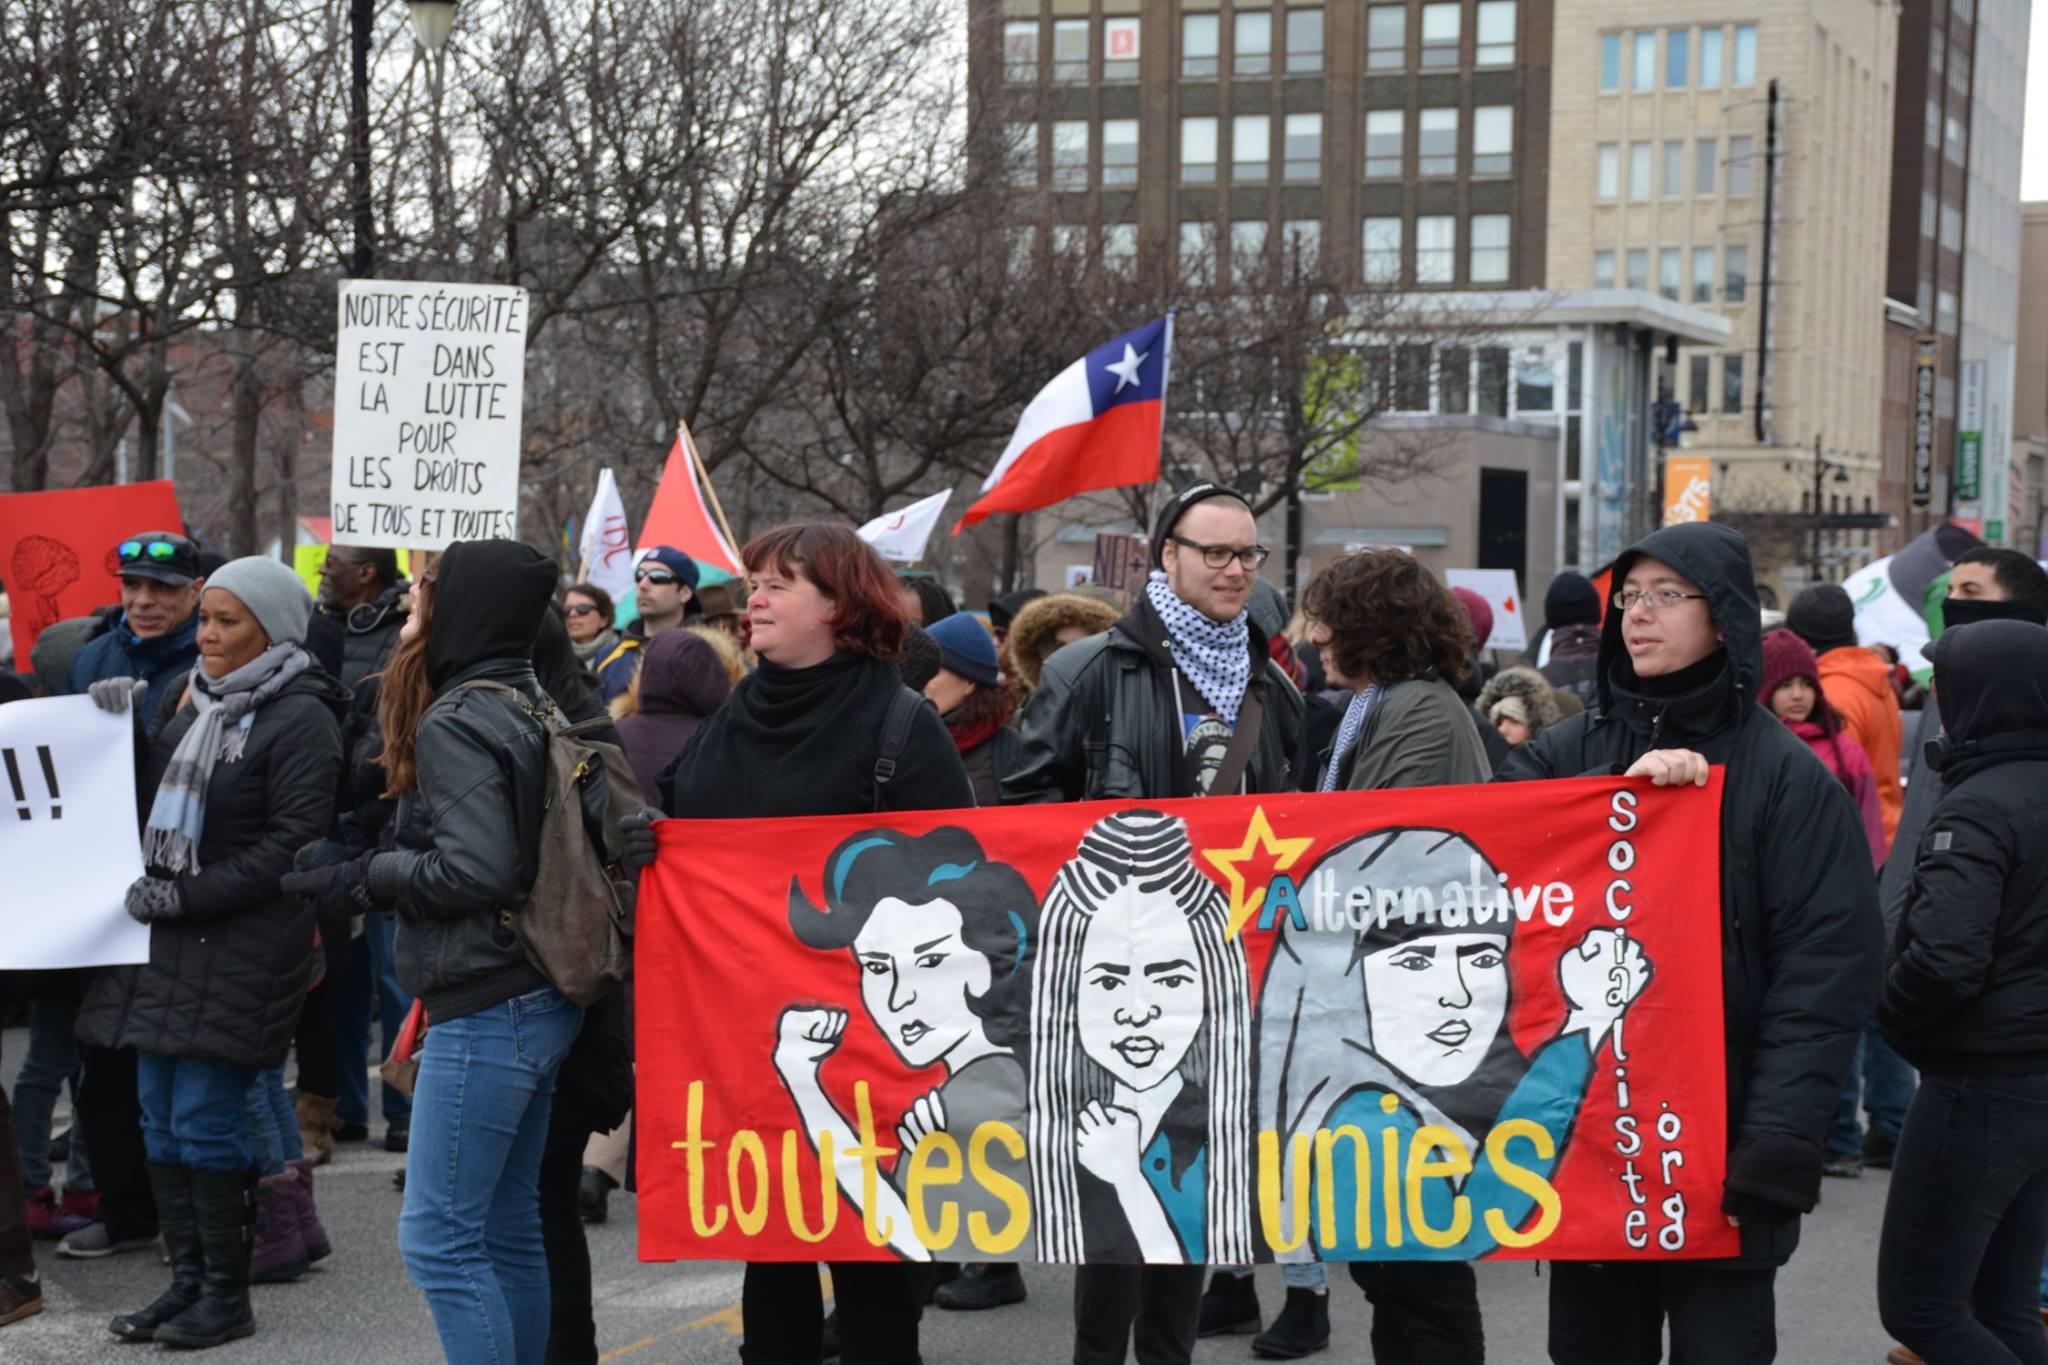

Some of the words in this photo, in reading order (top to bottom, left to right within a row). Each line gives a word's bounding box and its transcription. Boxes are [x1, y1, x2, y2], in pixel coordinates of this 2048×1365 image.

[345, 294, 413, 329] NOTRE
[359, 342, 405, 376] EST
[433, 344, 495, 378] DANS
[360, 382, 389, 414] LA
[425, 382, 507, 419] LUTTE
[398, 422, 457, 455] POUR
[349, 456, 392, 489] LES
[335, 503, 358, 533] DE
[368, 504, 412, 537] TOUS
[421, 508, 444, 539] ET
[452, 510, 515, 539] TOUTES
[1257, 853, 1575, 931] Alternative
[671, 1080, 1031, 1254] toutes
[1258, 1093, 1563, 1253] unies
